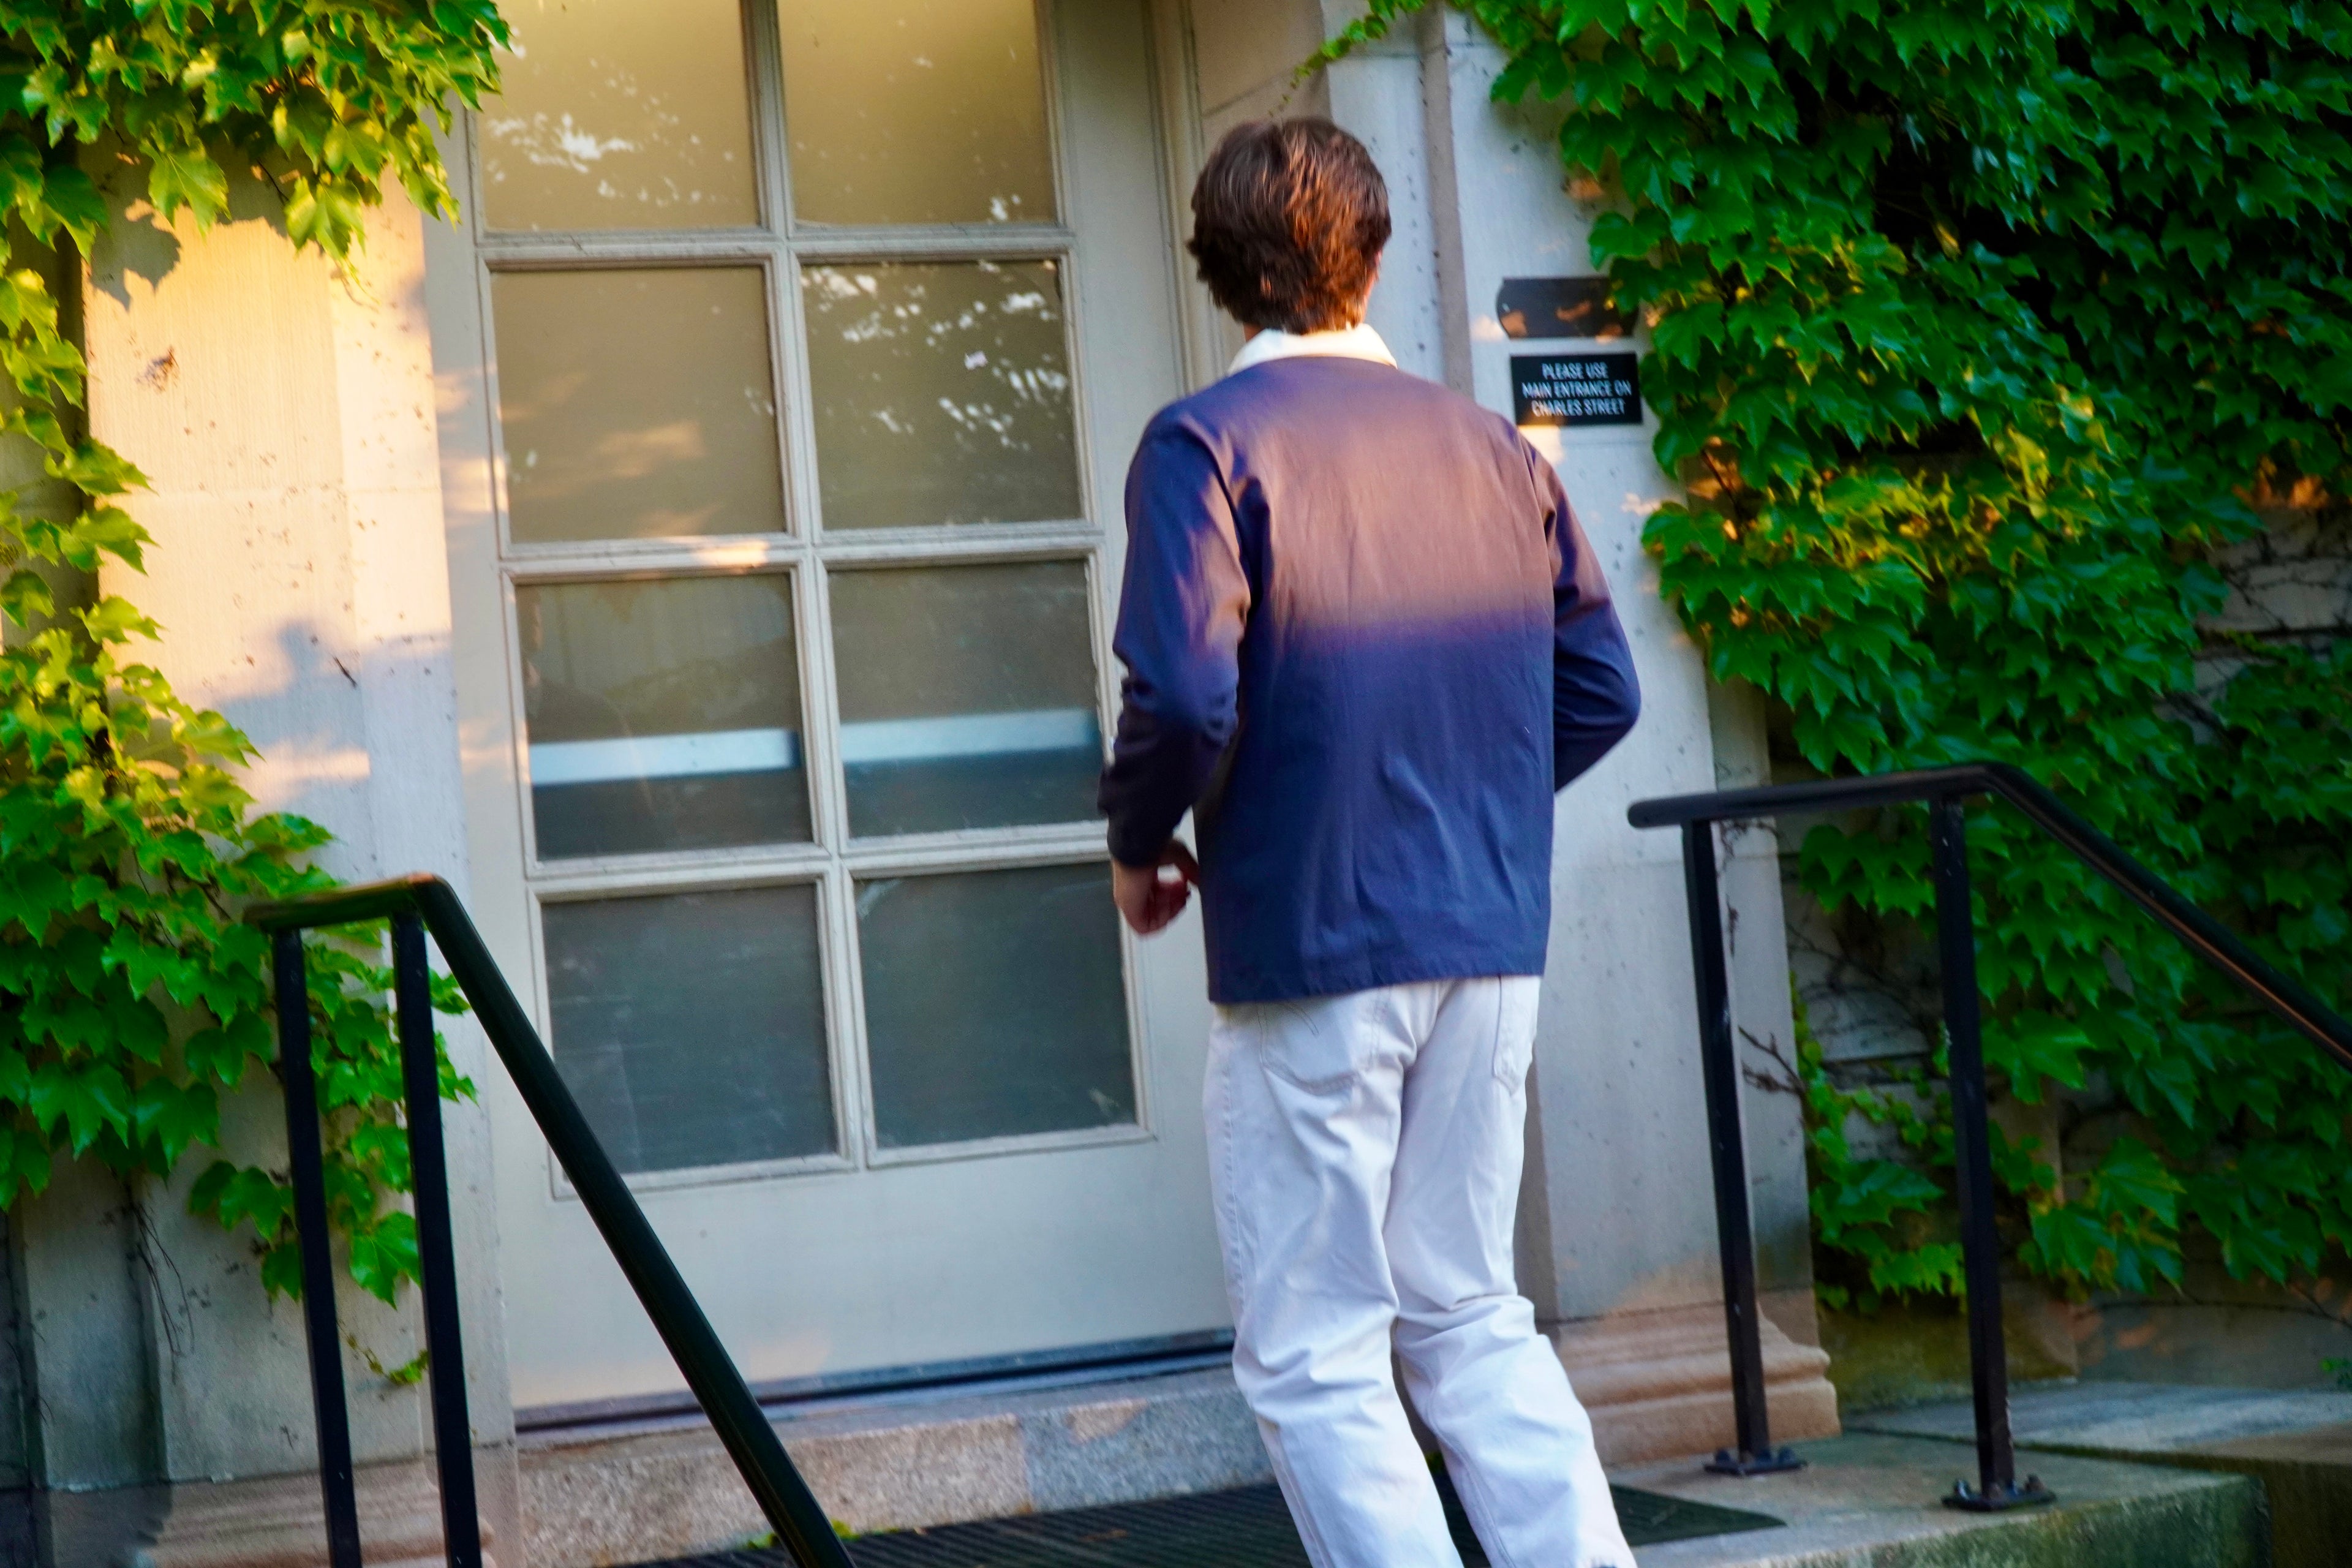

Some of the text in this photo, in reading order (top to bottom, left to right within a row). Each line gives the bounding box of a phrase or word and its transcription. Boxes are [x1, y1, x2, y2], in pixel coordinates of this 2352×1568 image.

[1542, 361, 1609, 380] PLEASE USE
[1521, 379, 1632, 398] MAIN ENTRANCE ON
[1531, 398, 1625, 417] CHARLES STREET
